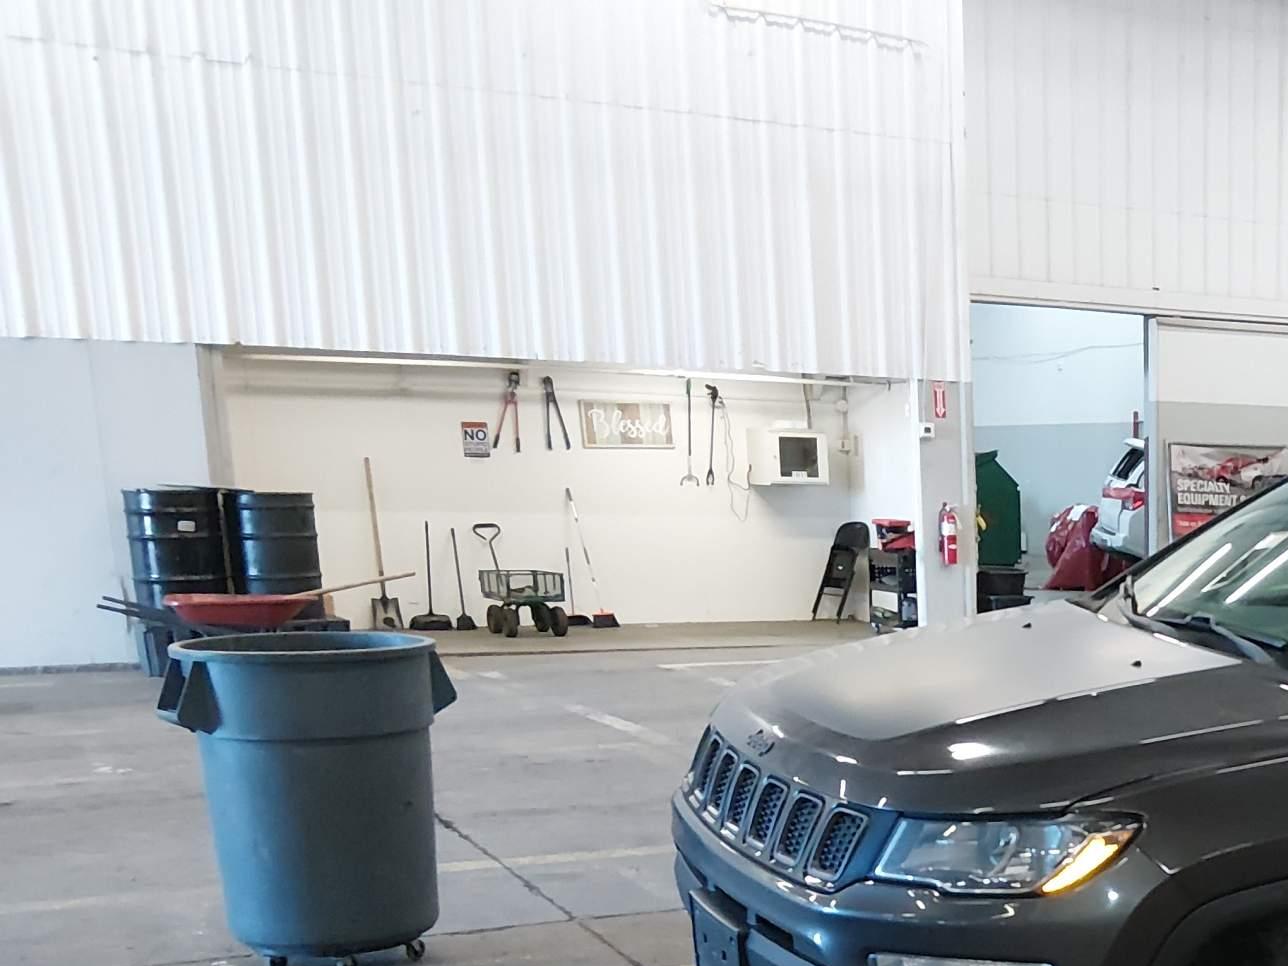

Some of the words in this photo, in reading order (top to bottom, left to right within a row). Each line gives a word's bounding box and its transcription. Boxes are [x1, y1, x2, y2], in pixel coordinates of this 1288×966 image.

[588, 408, 670, 438] Blessed
[464, 429, 487, 441] NO
[1176, 479, 1231, 494] SPECIALTY
[1177, 492, 1238, 506] EQUIPMENT
